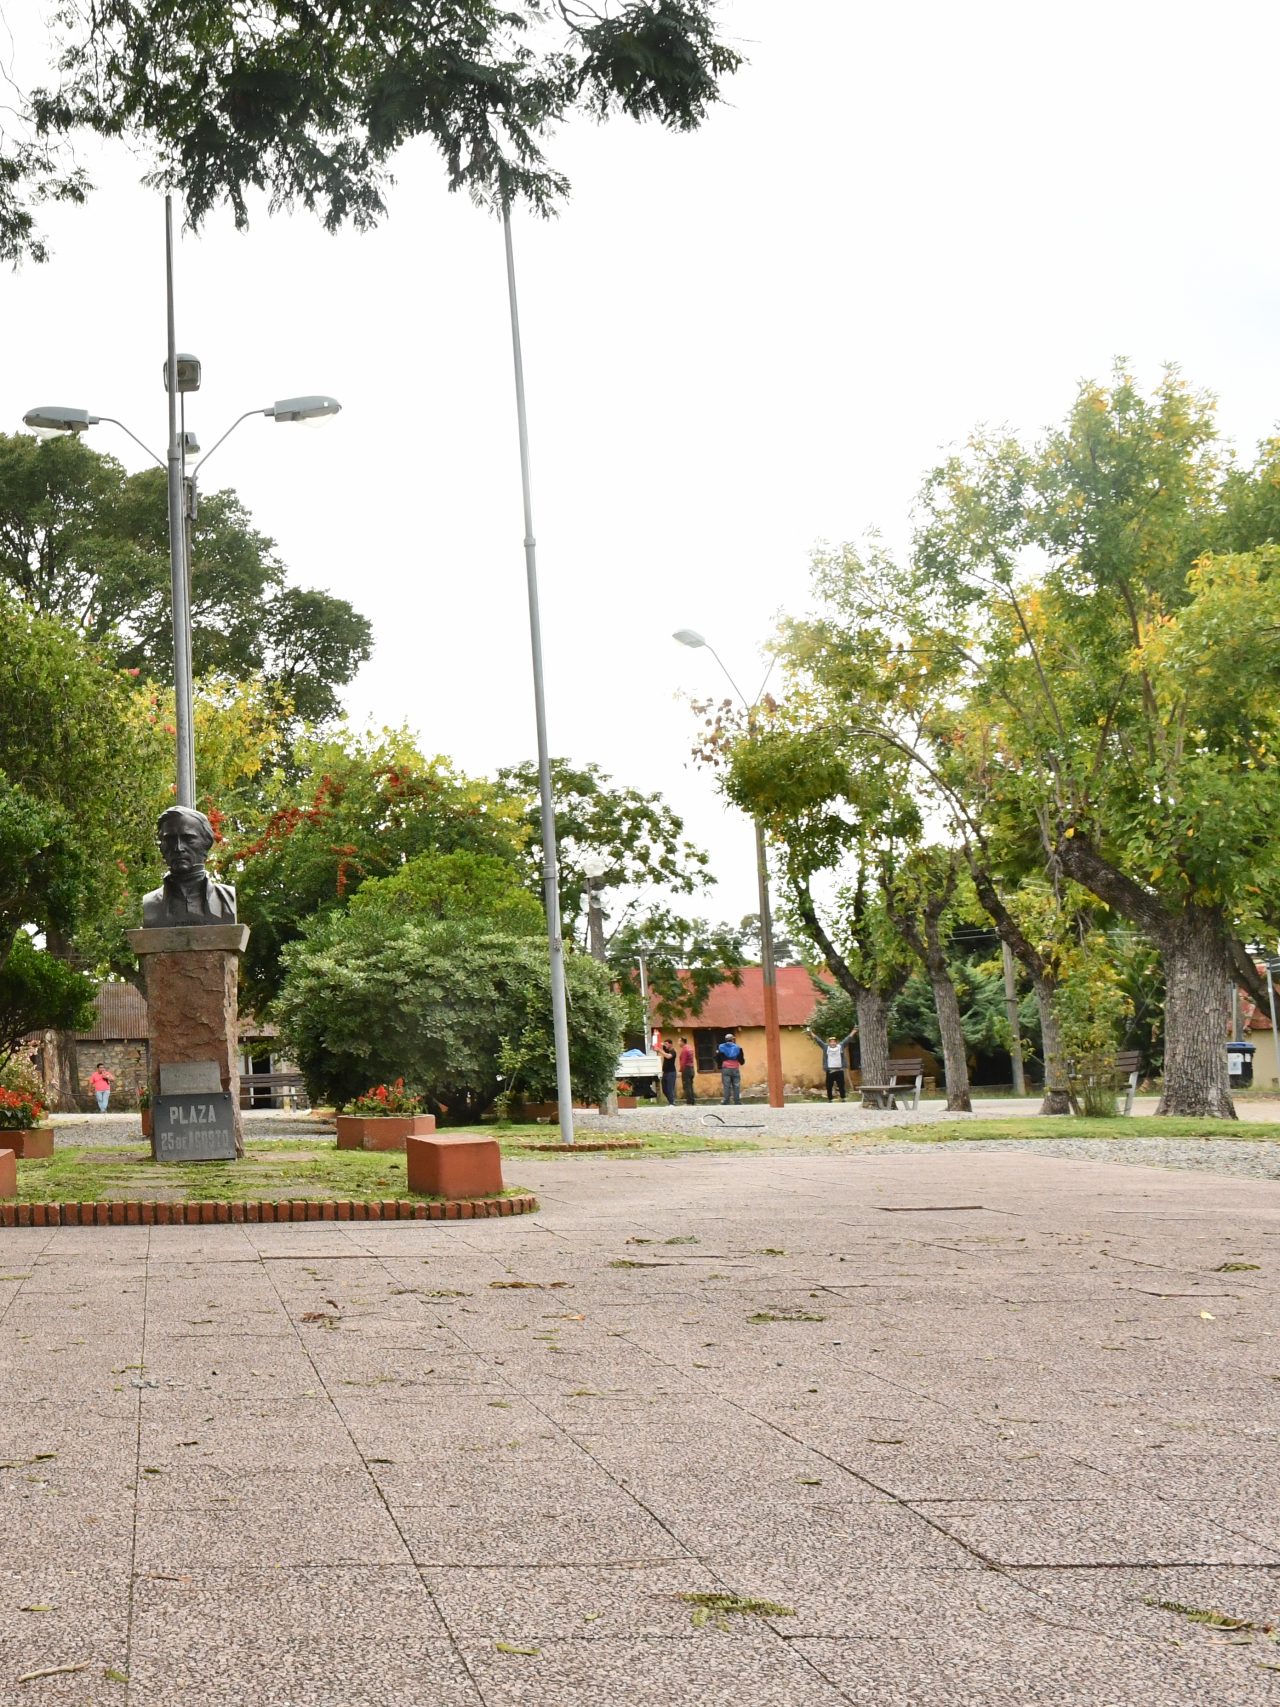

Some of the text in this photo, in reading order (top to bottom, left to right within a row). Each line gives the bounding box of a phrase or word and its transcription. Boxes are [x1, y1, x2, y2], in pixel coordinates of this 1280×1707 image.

[169, 1105, 216, 1124] PLAZA
[161, 1132, 174, 1150] 25
[189, 1130, 228, 1149] AGOSTO
